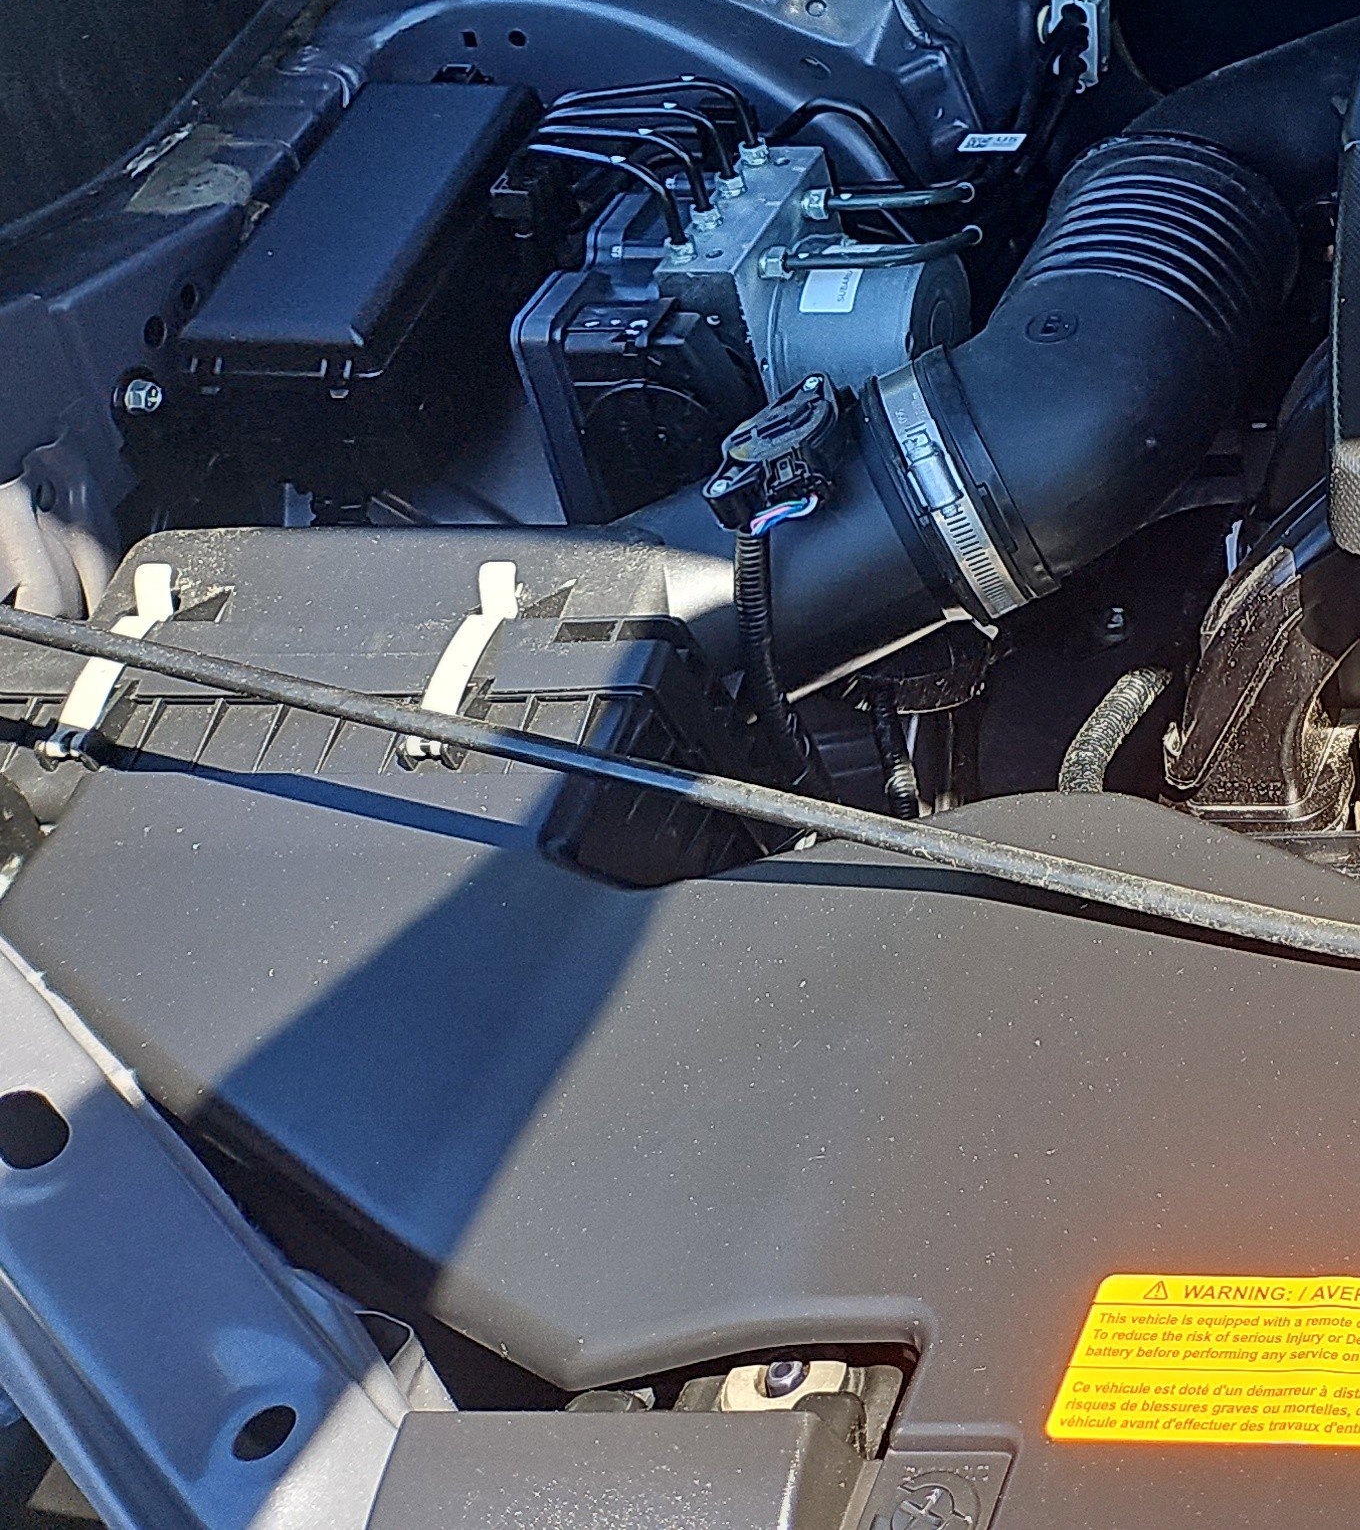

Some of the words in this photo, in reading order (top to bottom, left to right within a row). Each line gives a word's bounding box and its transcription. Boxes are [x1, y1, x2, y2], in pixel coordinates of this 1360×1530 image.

[1184, 1285, 1293, 1302] WARNING:
[1297, 1286, 1306, 1302] /
[1100, 1312, 1126, 1324] This
[1131, 1314, 1178, 1325] vehicle
[1197, 1315, 1259, 1329] equipped
[1263, 1316, 1290, 1327] with
[1294, 1318, 1302, 1327] a
[1305, 1316, 1352, 1328] remote
[1093, 1329, 1108, 1340] To
[1112, 1330, 1158, 1341] reduce
[1162, 1330, 1182, 1342] the
[1186, 1330, 1210, 1342] risk
[1216, 1330, 1230, 1342] of
[1232, 1332, 1282, 1343] serious
[1286, 1332, 1324, 1345] Injury
[1328, 1334, 1342, 1343] or
[1085, 1346, 1133, 1358] battery
[1136, 1346, 1180, 1358] before
[1183, 1348, 1258, 1362] performing
[1261, 1350, 1287, 1362] any
[1290, 1348, 1338, 1360] service
[1342, 1352, 1360, 1362] on
[1072, 1382, 1090, 1393] Ce
[1094, 1382, 1150, 1394] véhicule
[1154, 1384, 1175, 1395] est
[1178, 1384, 1209, 1396] doté
[1212, 1384, 1242, 1396] d'un
[1246, 1384, 1317, 1397] démarreur
[1319, 1385, 1328, 1398] à
[1065, 1399, 1116, 1413] risques
[1120, 1400, 1138, 1412] de
[1141, 1400, 1208, 1413] blessures
[1212, 1404, 1258, 1416] graves
[1262, 1404, 1280, 1414] ou
[1283, 1404, 1351, 1418] mortelles,
[1060, 1416, 1117, 1428] véhicule
[1120, 1418, 1158, 1429] avant
[1162, 1418, 1237, 1430] d'effectuer
[1240, 1418, 1264, 1432] des
[1268, 1420, 1320, 1432] travaux
